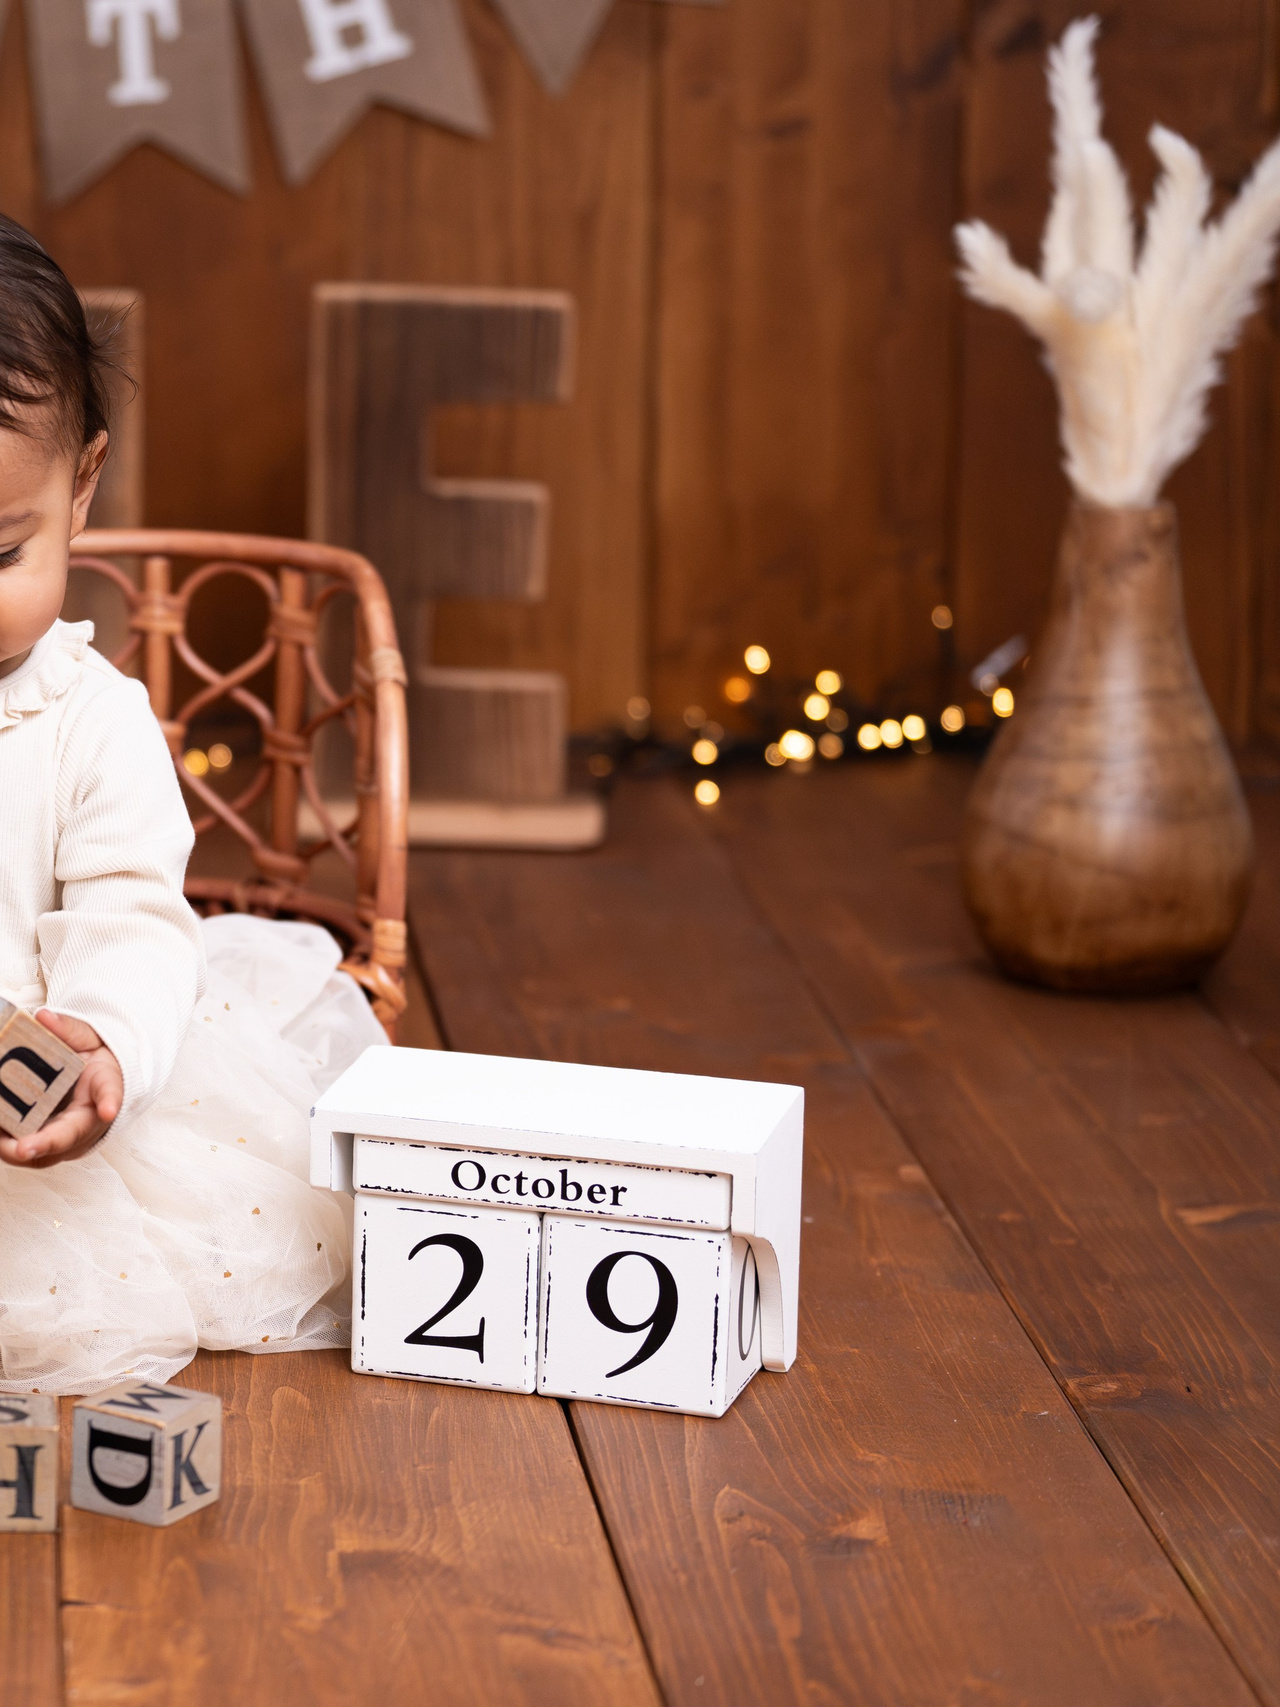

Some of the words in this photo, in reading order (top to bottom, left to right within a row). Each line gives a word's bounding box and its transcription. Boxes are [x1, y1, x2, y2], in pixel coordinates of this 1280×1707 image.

[450, 1159, 628, 1208] October
[404, 1232, 680, 1379] 29
[87, 1418, 155, 1506] D
[168, 1420, 211, 1510] K
